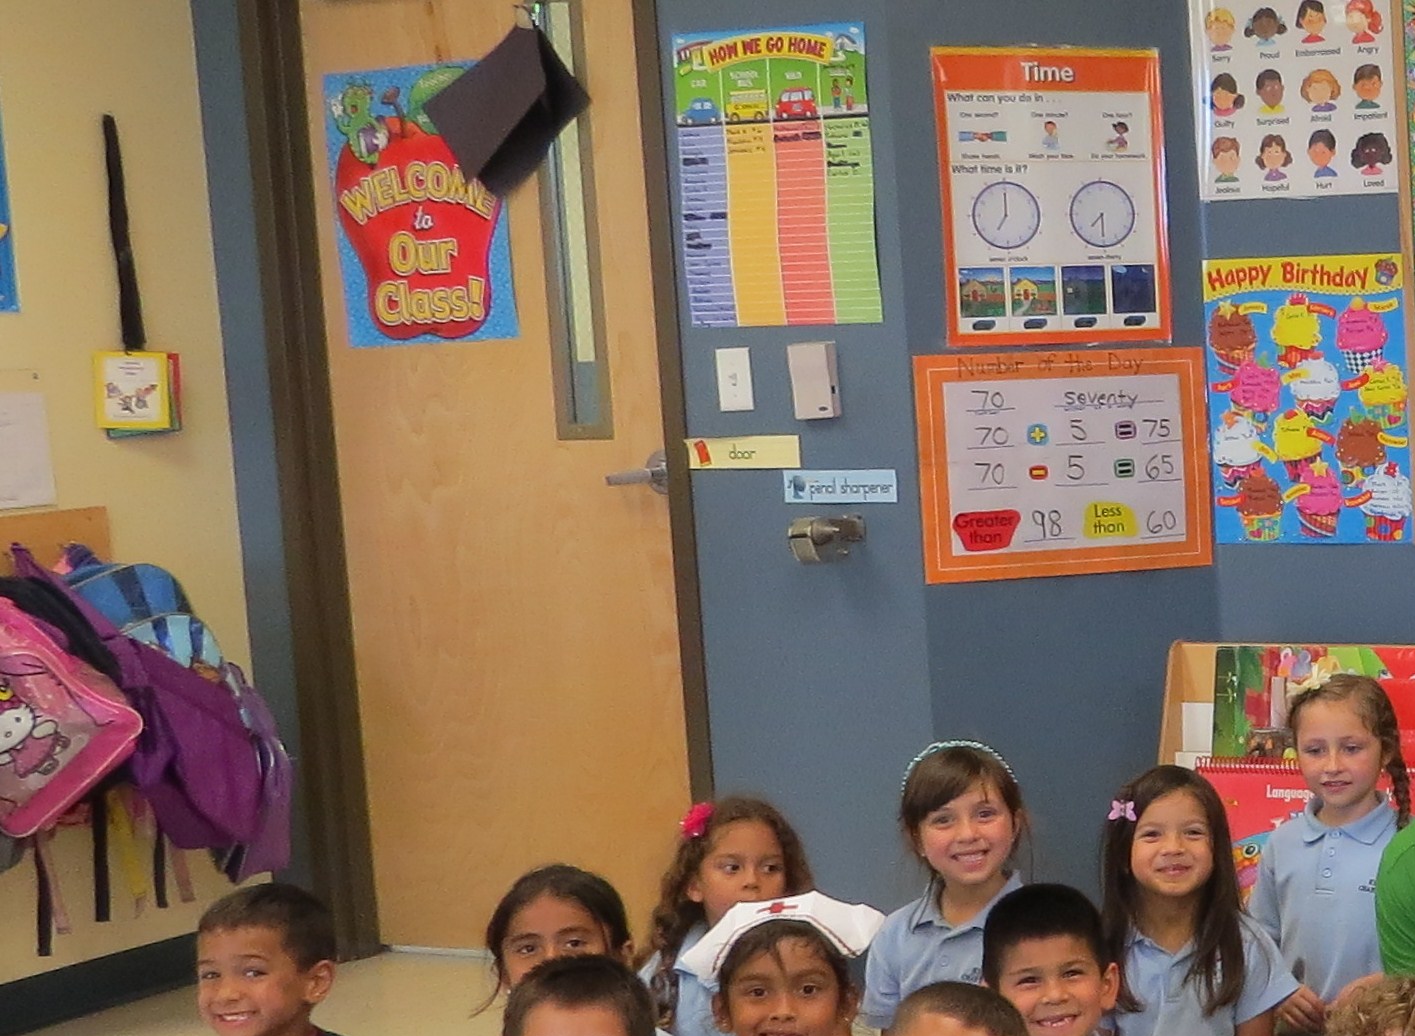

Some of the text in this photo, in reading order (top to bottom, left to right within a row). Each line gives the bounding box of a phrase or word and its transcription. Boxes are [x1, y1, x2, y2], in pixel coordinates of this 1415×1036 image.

[708, 36, 827, 66] HOW WE GO HOME
[1260, 51, 1280, 59] Proud
[1357, 46, 1379, 55] Angry
[1212, 55, 1231, 63] Sorry
[1020, 61, 1075, 82] Time
[947, 93, 975, 102] What
[997, 95, 1016, 105] you
[1019, 93, 1033, 102] do
[1035, 94, 1044, 102] in
[1257, 117, 1289, 126] Surprised
[1354, 112, 1388, 121] Impatient
[1215, 120, 1235, 129] Guilty
[952, 164, 1028, 174] What time is it?
[1262, 183, 1289, 193] Hopeful
[1363, 179, 1384, 187] Loved
[413, 206, 434, 230] to
[388, 231, 458, 277] Our
[1207, 261, 1369, 291] Happy Birthday
[375, 276, 485, 326] Class!
[957, 357, 1024, 379] Number
[1038, 353, 1053, 372] of
[1108, 352, 1144, 375] Day
[971, 390, 1138, 410] 70 seventy
[975, 419, 1171, 445] 70 5 75
[729, 444, 756, 460] door
[975, 455, 1174, 485] 70 5 65
[841, 478, 893, 500] sharpener
[1094, 504, 1122, 518] Less
[956, 514, 1015, 528] Greater
[1032, 510, 1061, 538] 98
[1093, 519, 1125, 533] than
[1147, 510, 1176, 534] 60
[969, 530, 1002, 544] than
